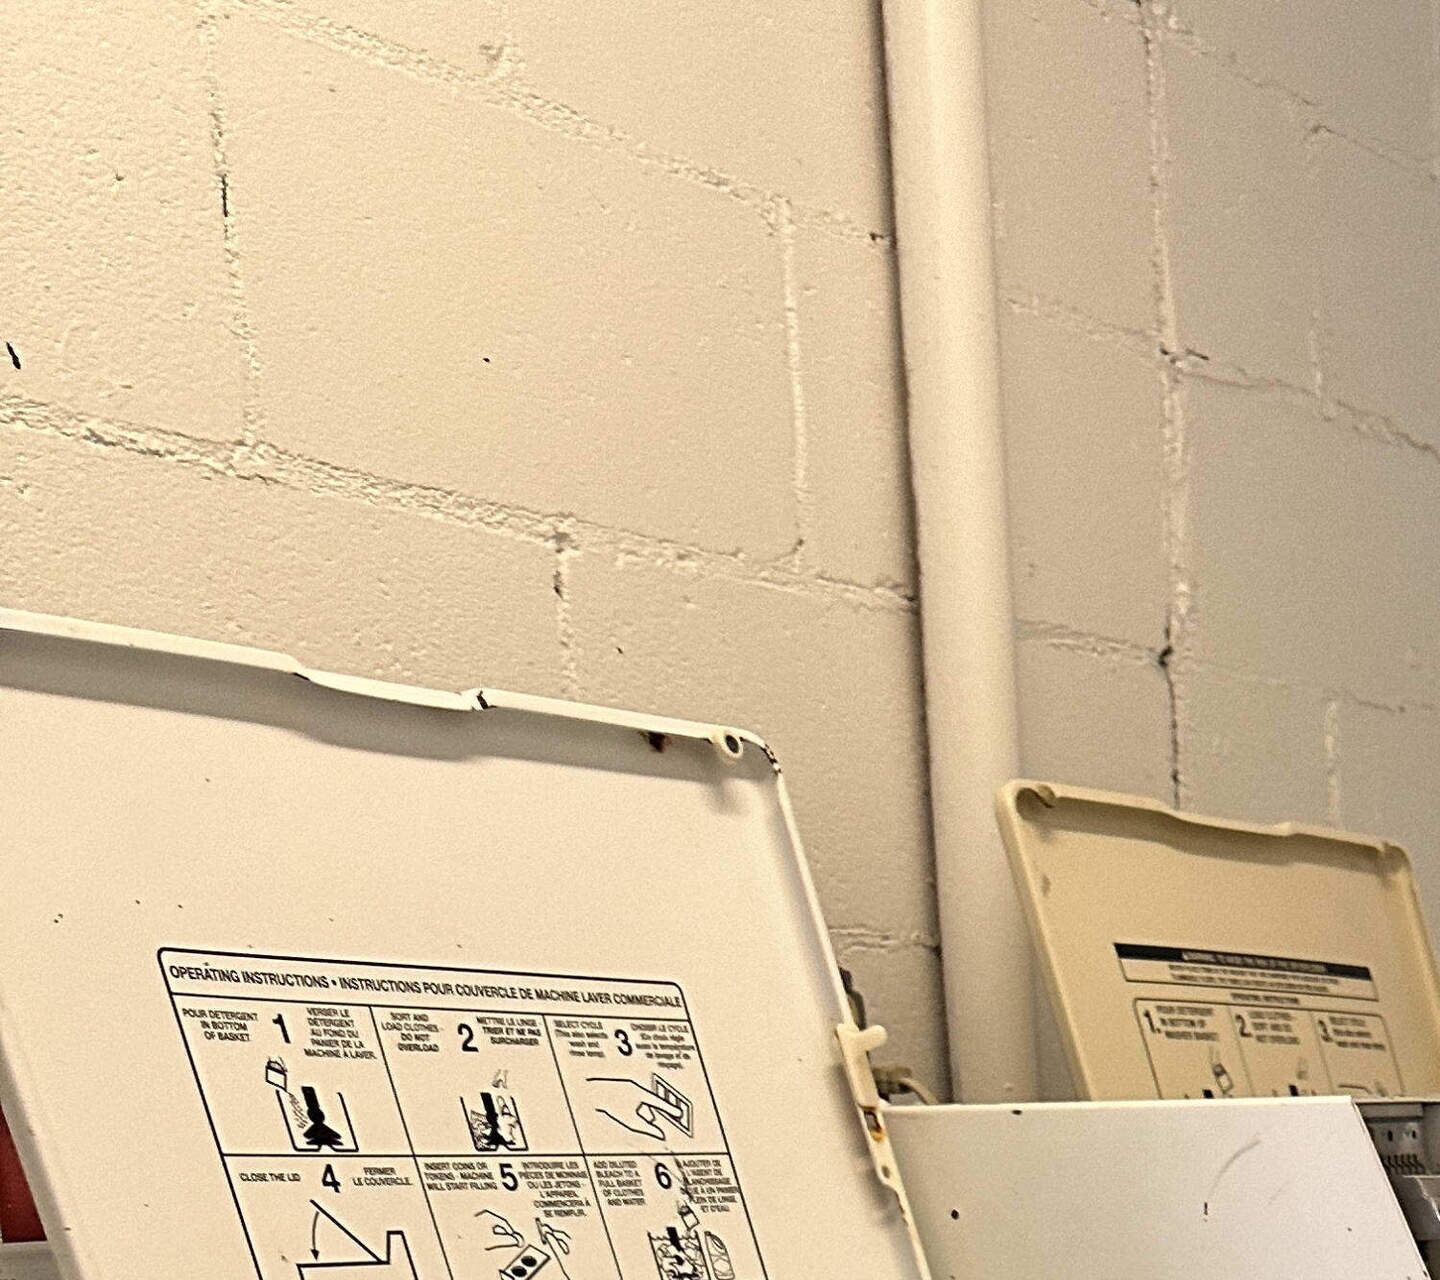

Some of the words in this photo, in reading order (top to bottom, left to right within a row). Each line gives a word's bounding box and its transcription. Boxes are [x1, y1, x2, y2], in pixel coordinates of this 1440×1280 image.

[169, 965, 240, 983] OPERATING
[241, 970, 329, 988] INSTRUCTIONS
[339, 976, 421, 994] INSTRUCTIONS
[422, 981, 453, 995] POUR
[455, 983, 518, 999] COUVERCLE
[520, 987, 533, 1000] DE
[534, 988, 581, 1002] MACHINE
[613, 993, 682, 1008] COMMERCIALE
[182, 1008, 207, 1018] POUR
[200, 1020, 210, 1029] IN
[212, 1021, 247, 1031] BOTTOM
[204, 1031, 215, 1040] OF
[219, 1032, 250, 1042] BASKET
[272, 1013, 291, 1044] 1
[457, 1023, 479, 1052] 2
[614, 1029, 633, 1056] 3
[322, 1164, 341, 1193] 4
[499, 1163, 519, 1191] 5
[654, 1162, 672, 1189] 6
